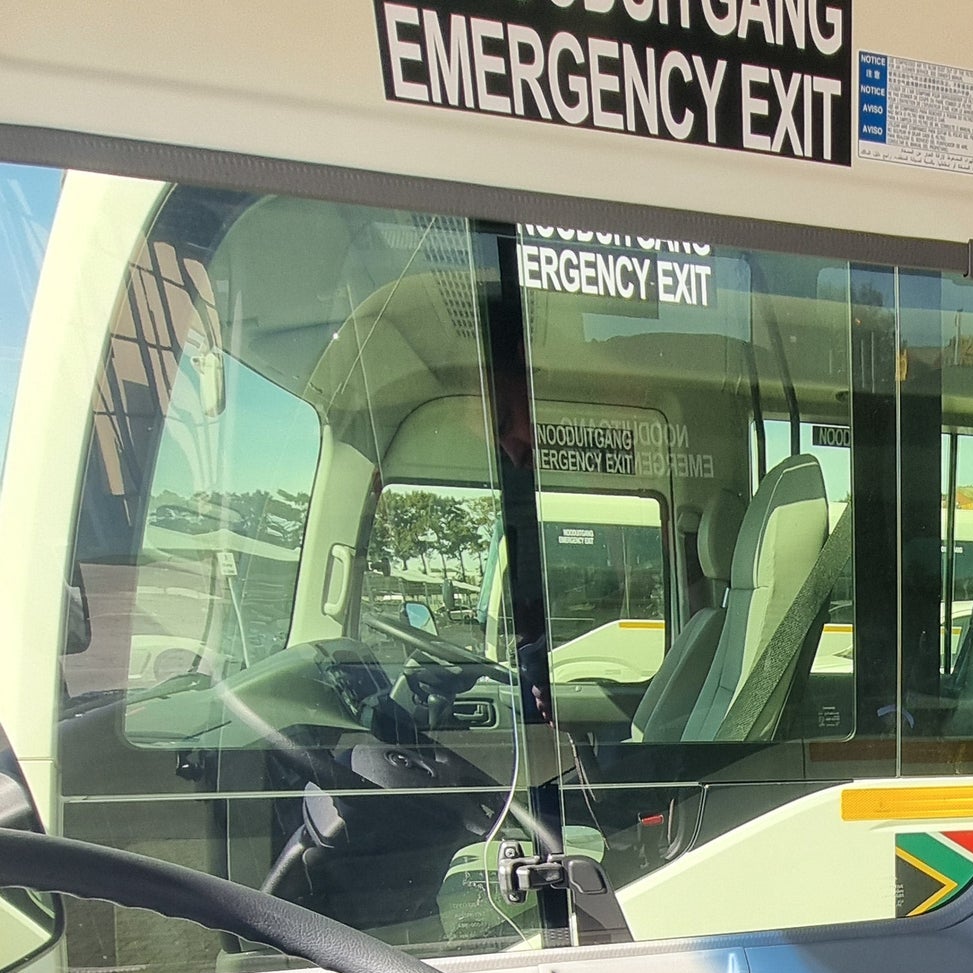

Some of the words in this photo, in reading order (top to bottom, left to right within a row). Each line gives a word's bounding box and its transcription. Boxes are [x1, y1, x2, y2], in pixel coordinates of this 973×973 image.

[860, 54, 886, 66] NOTICE
[385, 2, 727, 143] EMERGENCY
[741, 64, 842, 160] EXIT
[860, 85, 886, 97] NOTICE
[862, 103, 883, 115] AVISO
[862, 124, 883, 136] AVISO
[517, 243, 650, 300] ERGENCY
[656, 260, 712, 306] EXIT
[537, 424, 633, 450] NOODUITGANG
[537, 449, 602, 473] ERGENCY
[606, 453, 633, 475] EXIT
